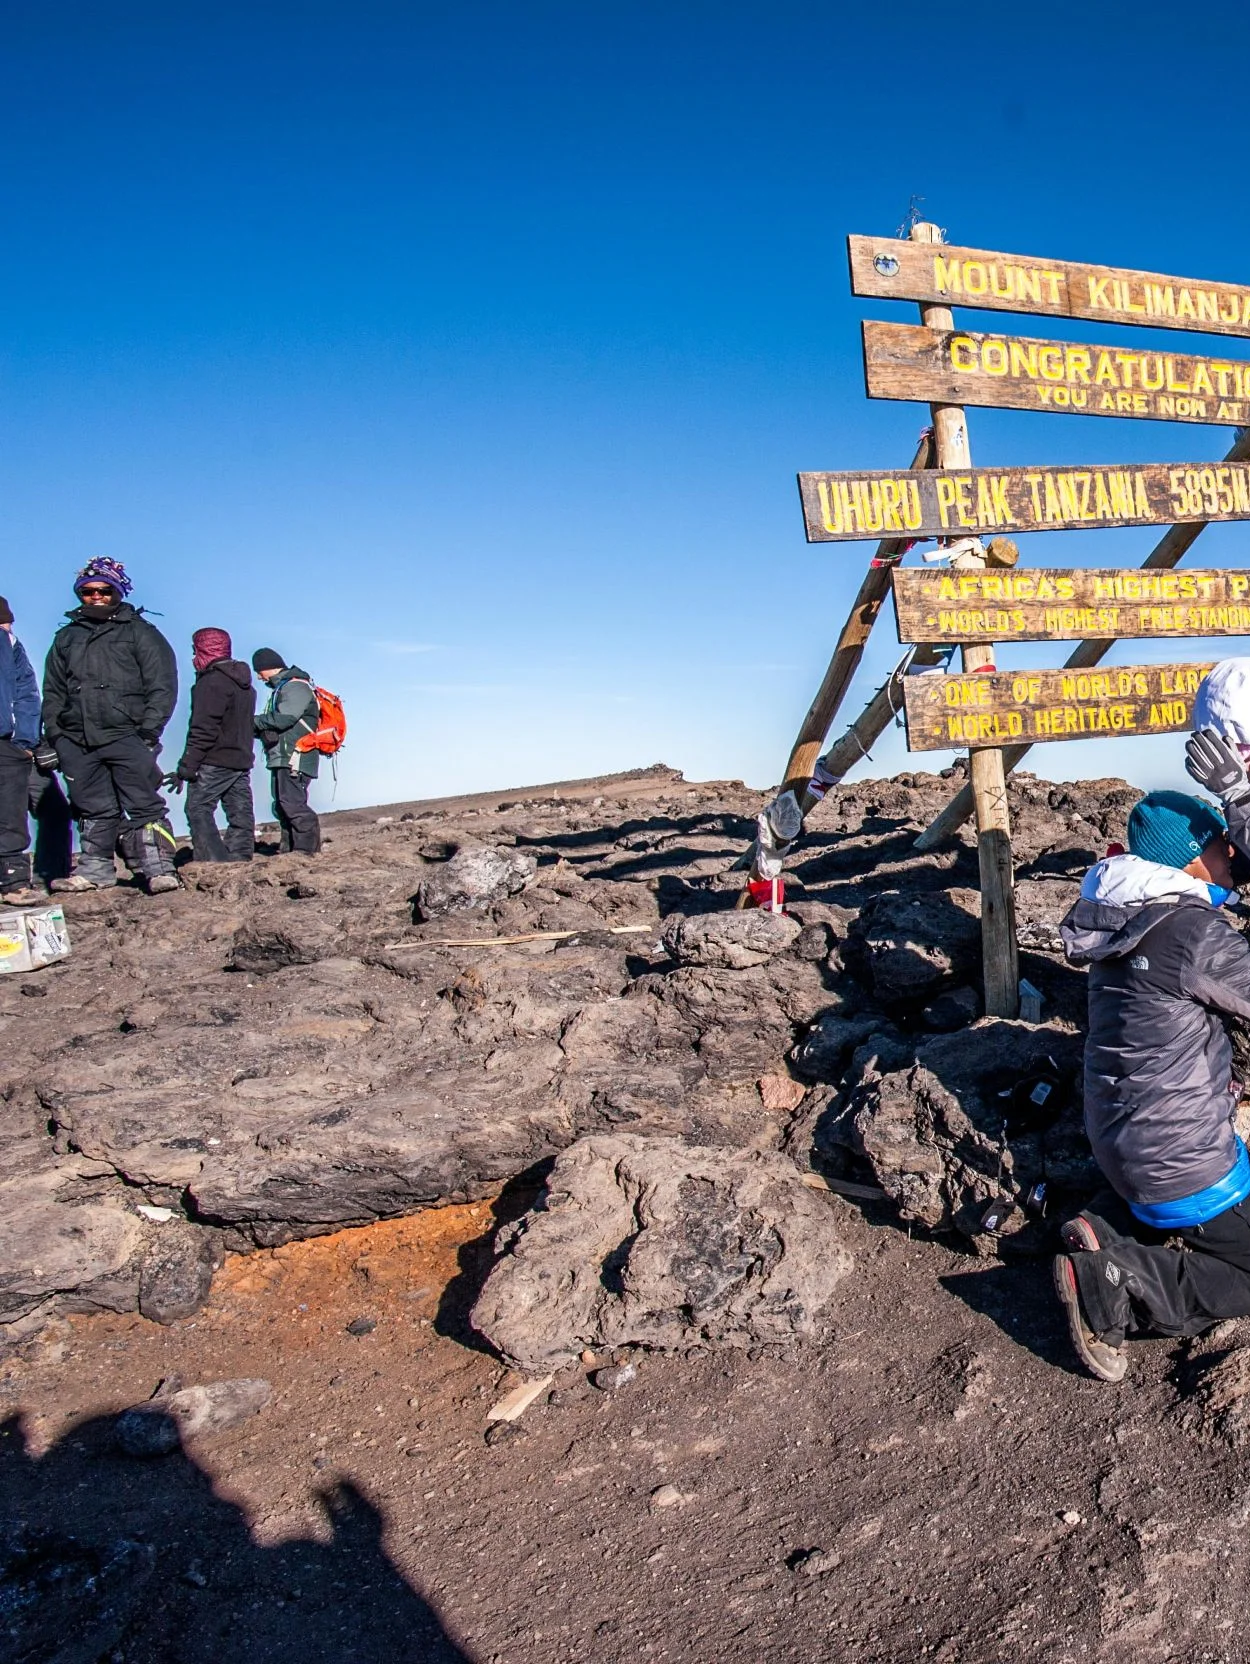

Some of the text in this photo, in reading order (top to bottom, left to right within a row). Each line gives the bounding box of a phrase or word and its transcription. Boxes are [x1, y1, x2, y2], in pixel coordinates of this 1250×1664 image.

[933, 255, 1065, 304] MOUNT
[1036, 384, 1242, 421] YOU ARE NOW AT
[818, 478, 923, 534] UHURU
[935, 475, 1016, 528] PEAK
[1094, 575, 1214, 600] HIGHEST
[1045, 607, 1121, 633] HIGHEST
[945, 679, 992, 707] ONE
[1012, 677, 1042, 704] OF
[947, 711, 1023, 739] WORLD
[1035, 703, 1137, 735] HERITAGE
[1149, 699, 1188, 727] AND
